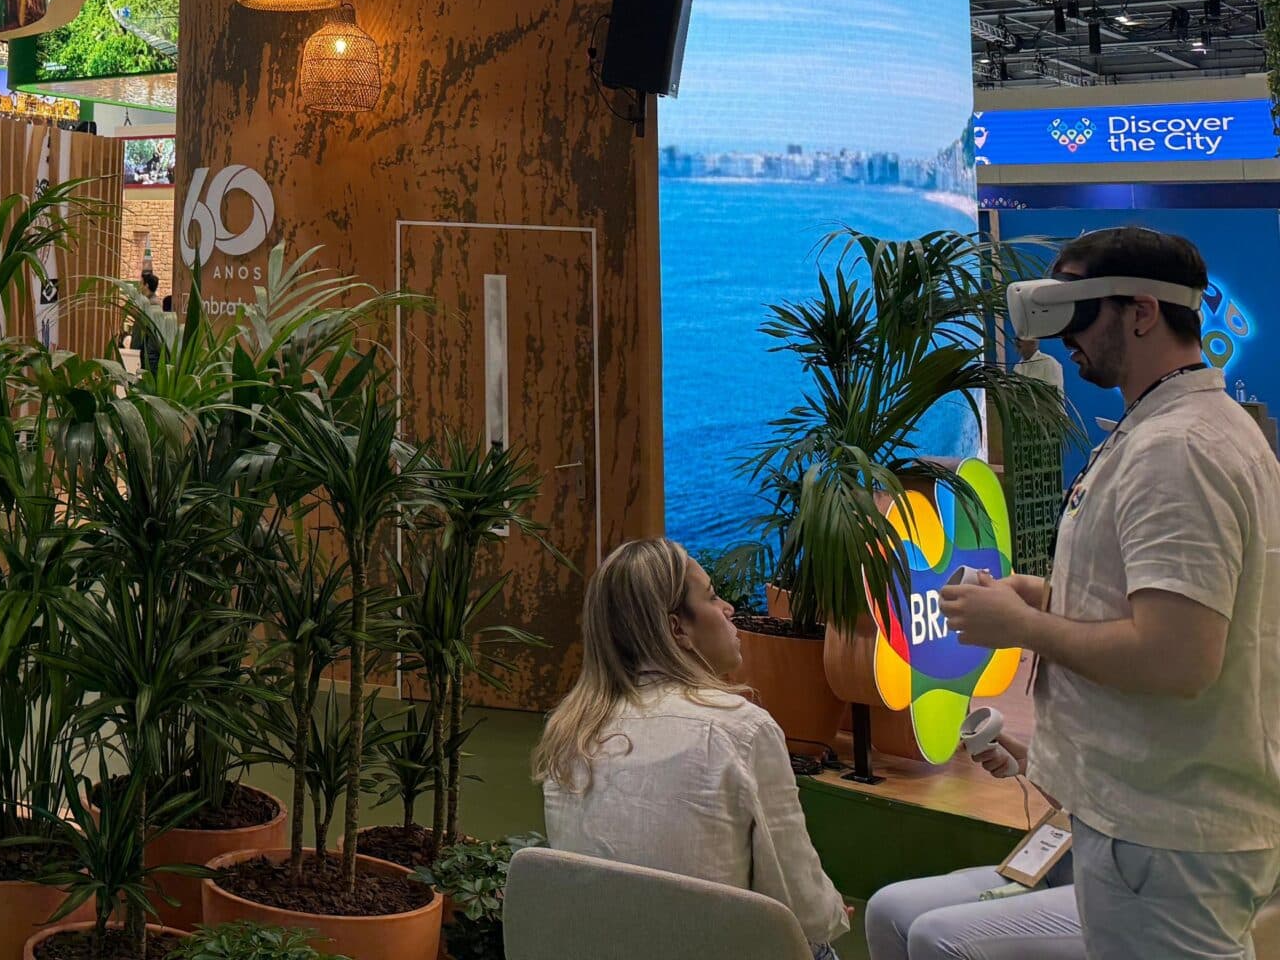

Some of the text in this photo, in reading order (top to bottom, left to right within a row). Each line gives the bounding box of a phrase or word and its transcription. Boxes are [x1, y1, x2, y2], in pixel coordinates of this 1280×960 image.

[1109, 116, 1234, 134] Discover
[1108, 131, 1223, 155] the City
[180, 164, 276, 268] 60
[213, 265, 262, 280] ANOS
